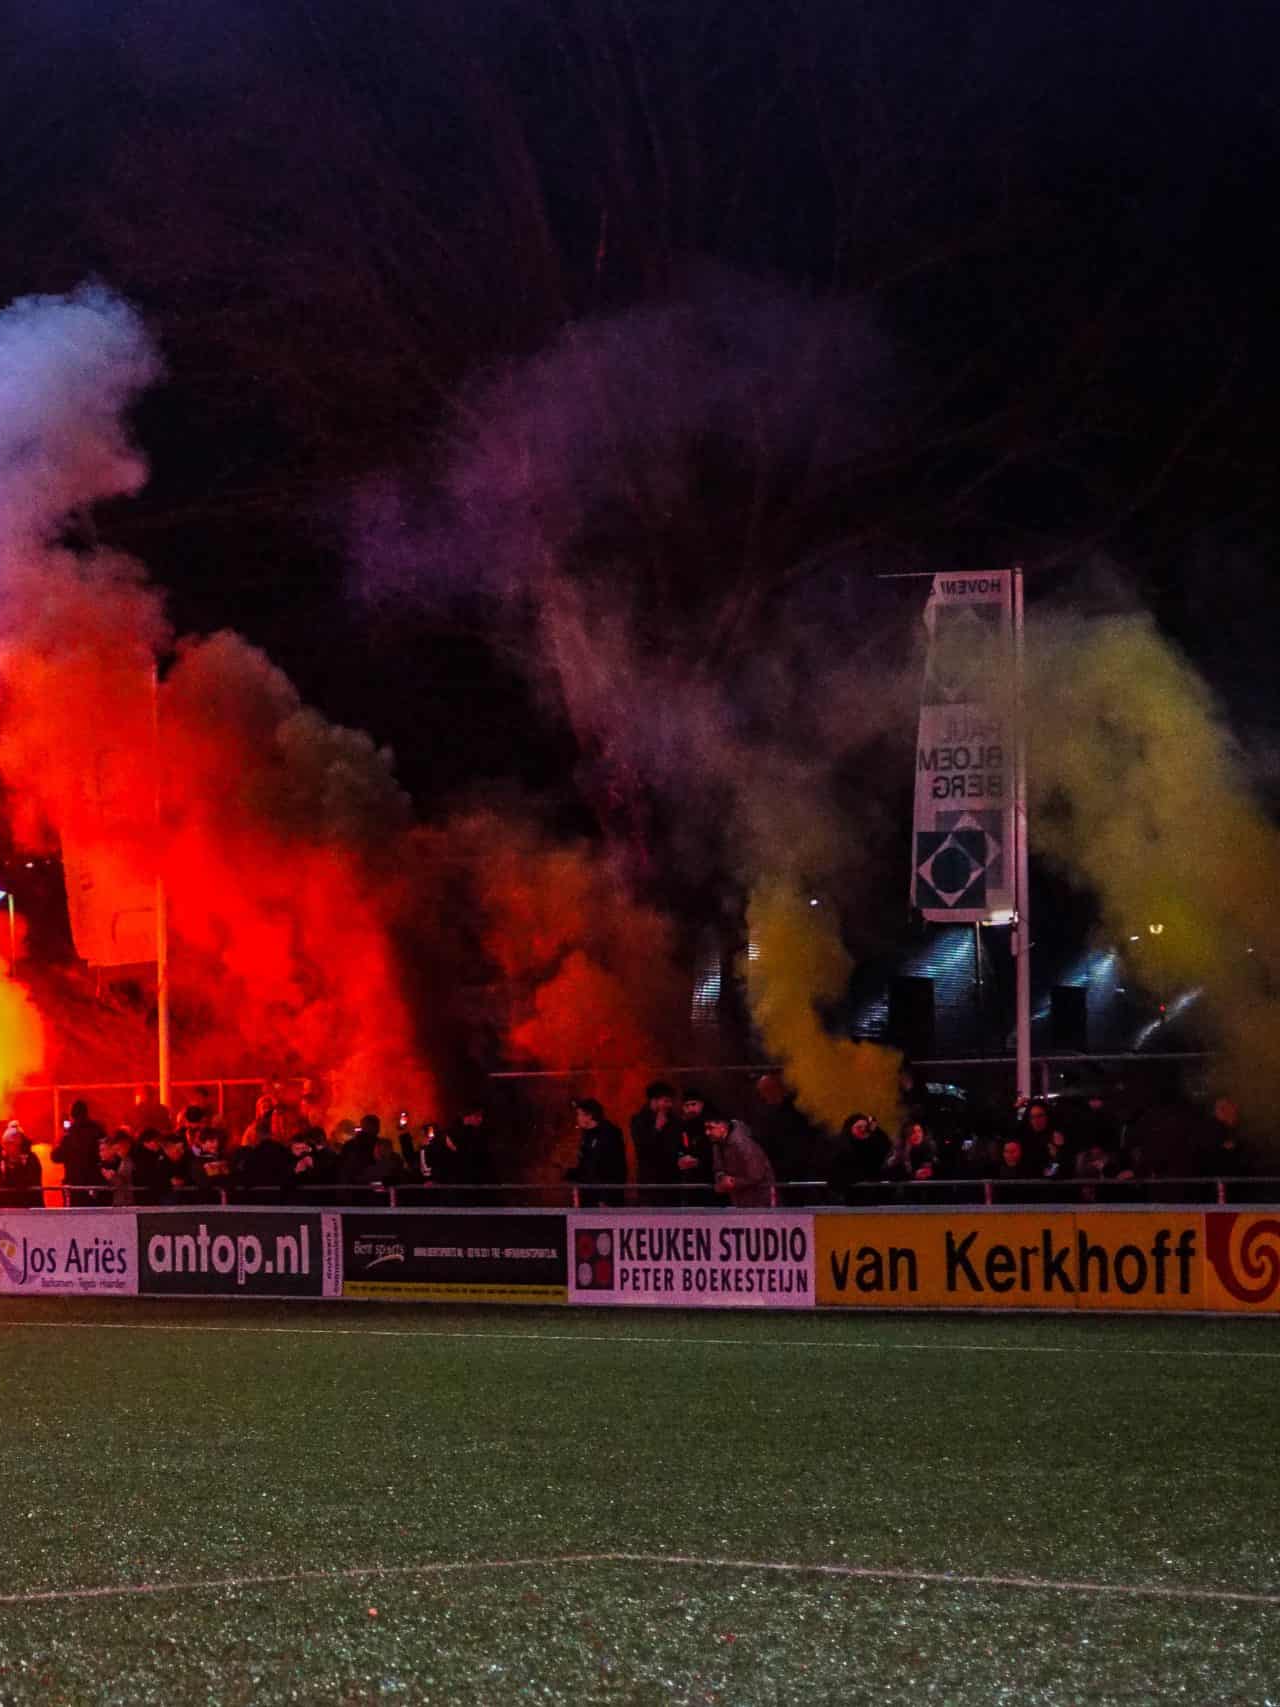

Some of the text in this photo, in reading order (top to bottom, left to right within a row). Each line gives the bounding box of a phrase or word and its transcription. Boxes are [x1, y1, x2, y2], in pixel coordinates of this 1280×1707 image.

[17, 1236, 128, 1285] Jos Ariës
[148, 1223, 310, 1285] antop.nl
[620, 1227, 807, 1262] KEUKEN STUDIO
[830, 1229, 1196, 1295] van Kerkhoff
[620, 1267, 808, 1293] PETER BOEKESTEIJN
